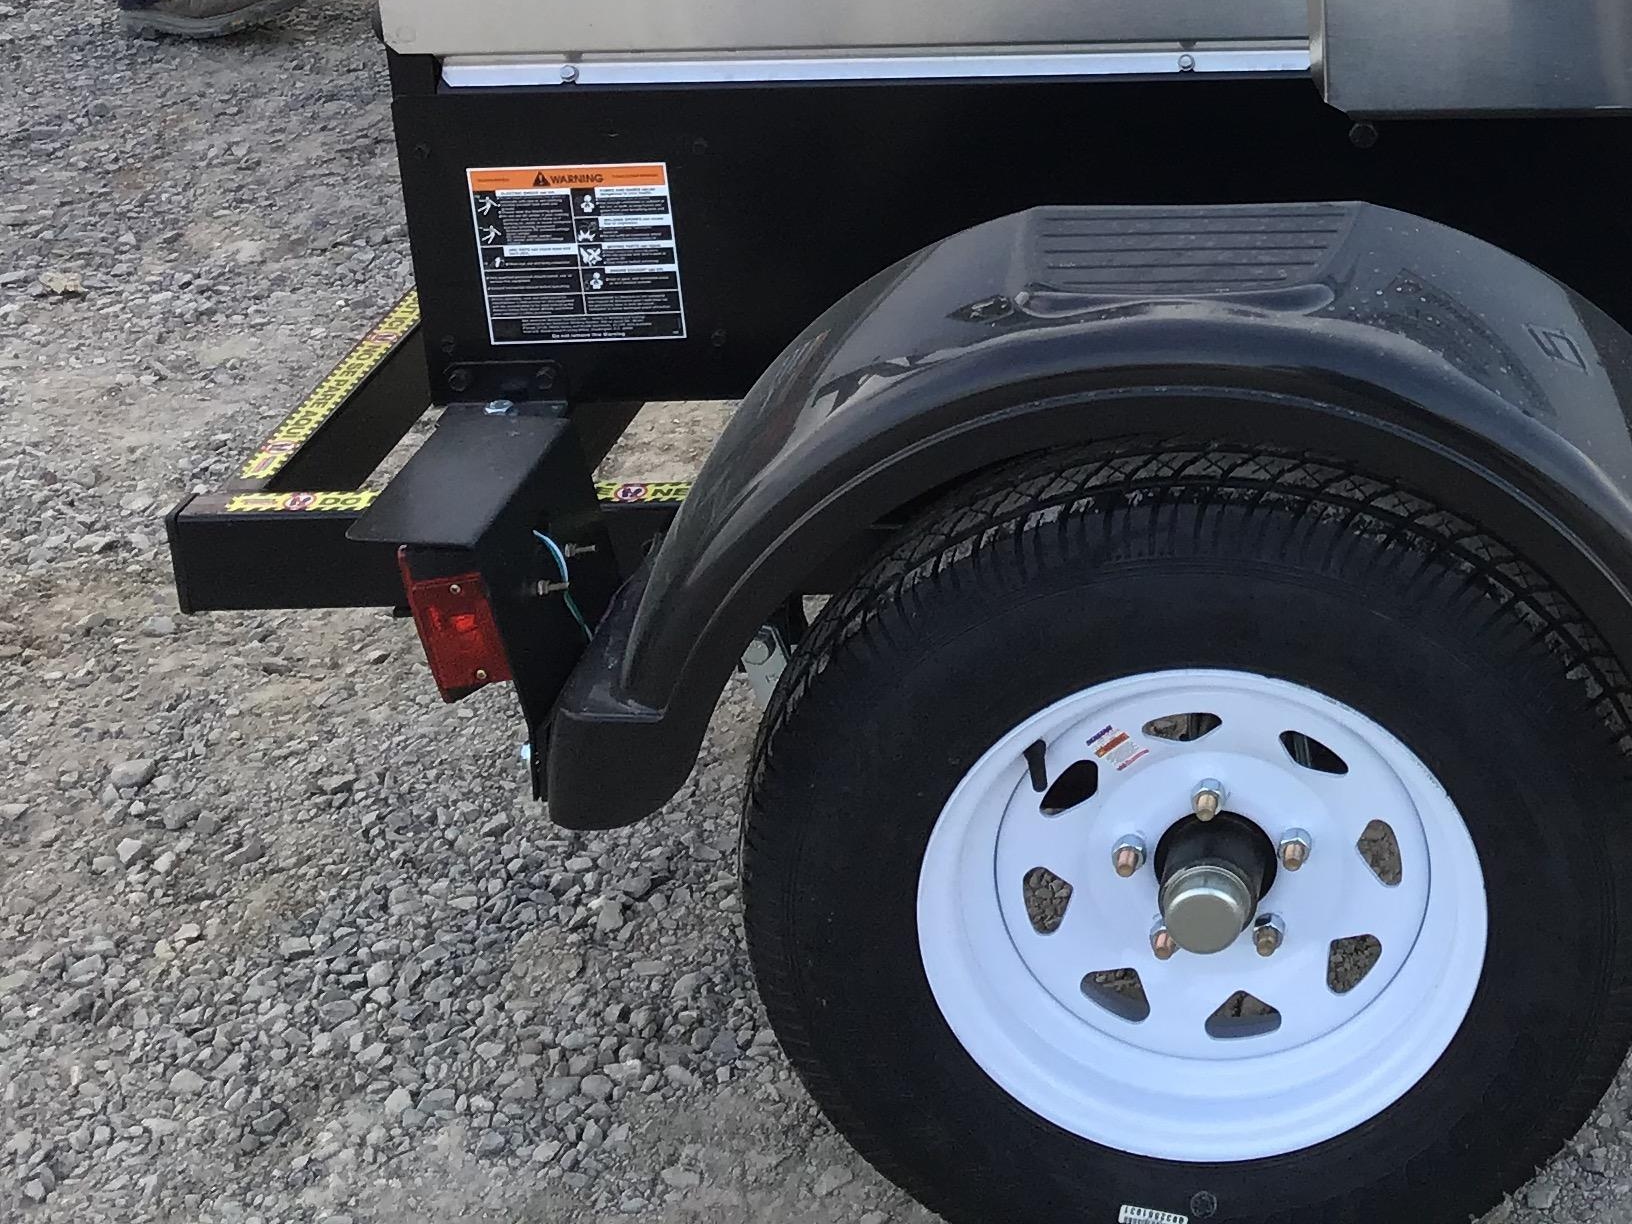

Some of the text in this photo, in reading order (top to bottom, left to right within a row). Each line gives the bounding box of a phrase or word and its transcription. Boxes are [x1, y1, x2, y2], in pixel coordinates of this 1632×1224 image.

[550, 173, 604, 185] WARNING
[310, 378, 345, 409] PARE
[319, 497, 361, 505] DO
